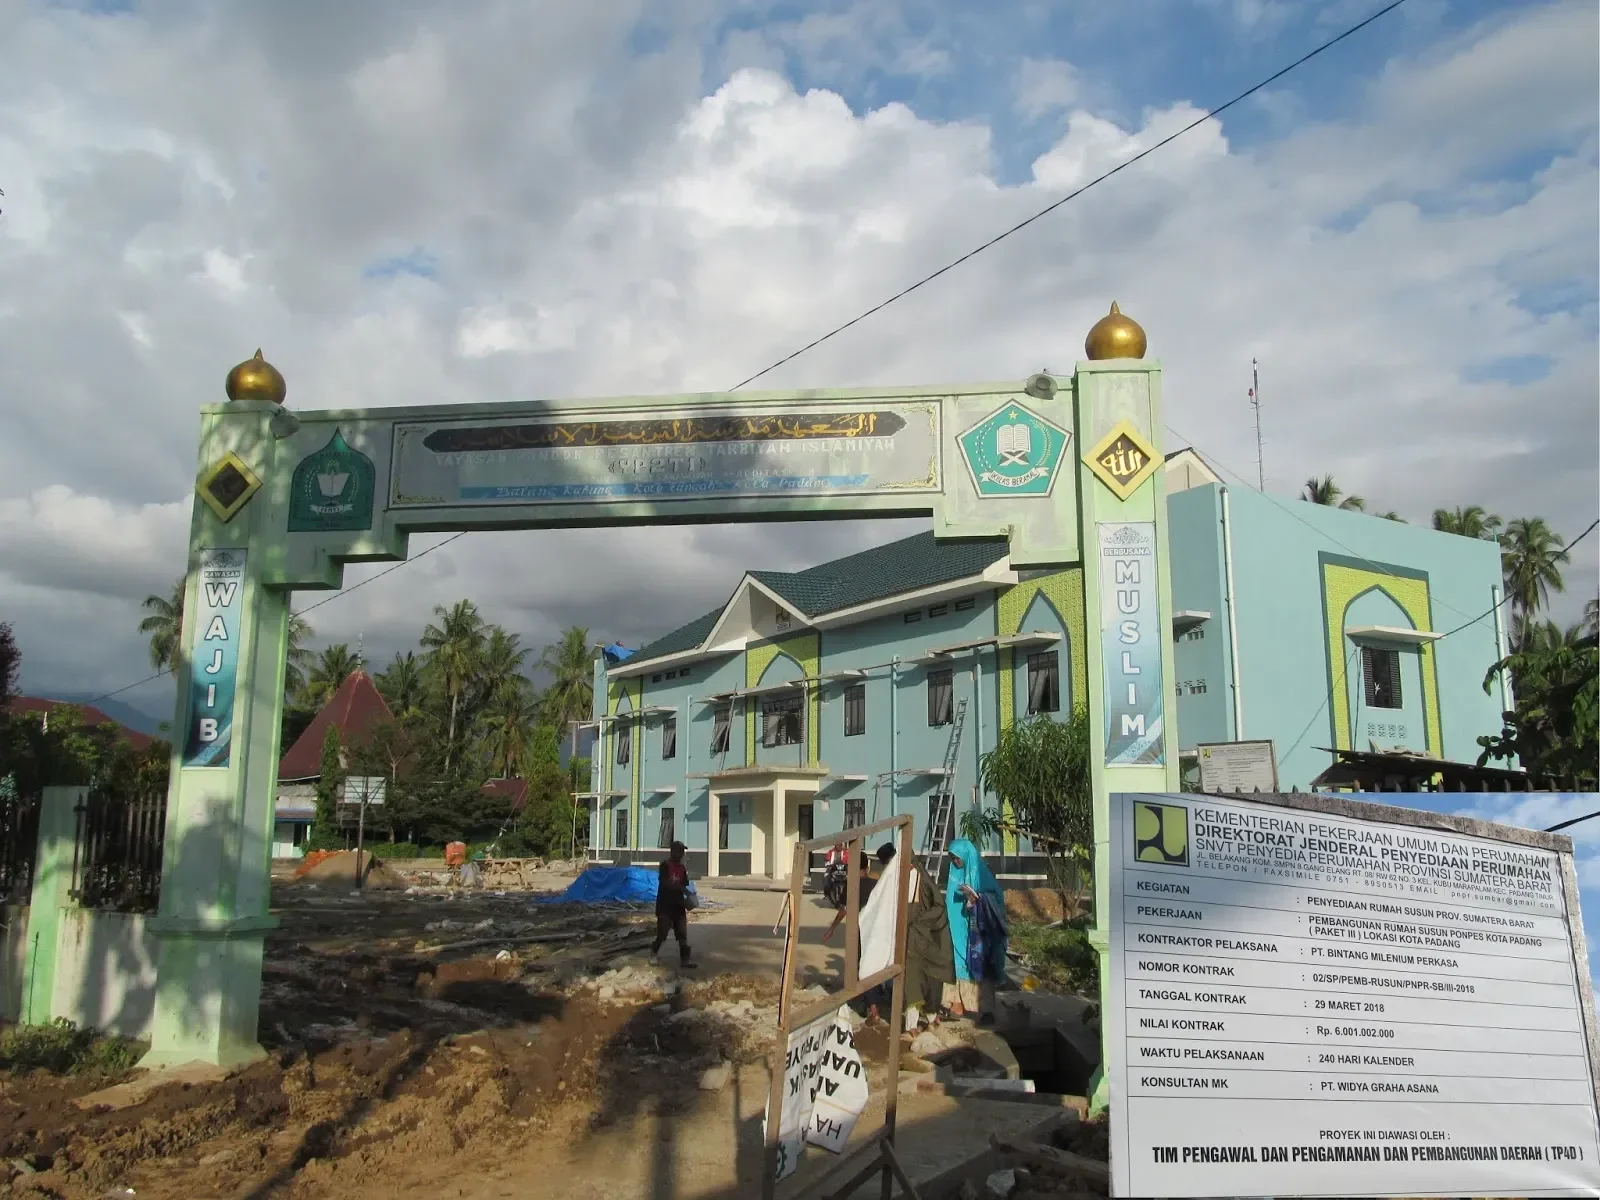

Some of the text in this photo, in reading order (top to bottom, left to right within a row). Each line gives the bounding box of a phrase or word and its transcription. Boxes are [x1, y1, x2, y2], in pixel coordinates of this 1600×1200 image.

[595, 446, 696, 460] PESANTREN
[706, 442, 791, 455] TARBIYAH
[801, 438, 895, 453] ISLAMIYAH
[1012, 470, 1039, 486] BERAMAL
[1103, 547, 1151, 557] BERBUSANA
[203, 569, 241, 579] KAWASAN
[1114, 559, 1145, 737] MUSLIM
[199, 582, 237, 741] WAJIB
[1194, 808, 1550, 868] KEMENTERIAN PEKERJAAN UMUM DAN PERUMAHAN
[1195, 823, 1551, 881] DIREKTORAT JENDERAL PENYEDIAAN PERUMAHAN
[1196, 838, 1552, 893] SNVT PENYEDIA PERUMAHAN PROVINSI SUMATERA BARAT
[1197, 861, 1248, 873] TELEPON
[1264, 867, 1320, 881] FAXSIMILE
[1410, 885, 1438, 895] EMAIL
[1209, 853, 1250, 864] BELAKANG
[1274, 861, 1296, 869] SMPN
[1303, 864, 1325, 873] GANG
[1326, 867, 1351, 876] ELANG
[1376, 872, 1388, 880] RW
[1433, 880, 1452, 888] KUBU
[1452, 882, 1492, 892] MARAPALAM
[1509, 890, 1535, 898] PADANG
[1535, 893, 1554, 901] TIMUR
[1137, 881, 1190, 894] KEGIATAN
[1137, 906, 1202, 920] PEKERJAAN
[1307, 896, 1367, 911] PENYEDIAAN
[1369, 903, 1402, 914] RUMAH
[1404, 907, 1434, 918] SUSUN
[1436, 910, 1462, 921] PROV.
[1463, 914, 1508, 926] SUMATERA
[1508, 920, 1535, 929] BARAT
[1309, 915, 1381, 931] PEMBANGUNAN
[1383, 923, 1416, 934] RUMAH
[1418, 926, 1448, 937] SUSUN
[1450, 930, 1484, 941] PONPES
[1485, 933, 1508, 944] KOTA
[1509, 936, 1542, 947] PADANG
[1315, 926, 1345, 938] PAKET
[1347, 930, 1356, 938] III
[1363, 931, 1397, 942] LOKASI
[1399, 934, 1424, 945] KOTA
[1425, 937, 1461, 948] PADANG
[1138, 933, 1278, 953] KONTRAKTOR PELAKSANA
[1311, 947, 1325, 957] PT.
[1327, 948, 1369, 960] BINTANG
[1370, 952, 1415, 964] MILENIUM
[1416, 956, 1459, 968] PERKASA
[1138, 961, 1235, 977] NOMOR KONTRAK
[1312, 973, 1475, 994] 02/SP/PEMB-RUSUN/PNPR-SB/III-2018
[1139, 989, 1247, 1004] TANGGAL KONTRAK
[1314, 1000, 1326, 1009] 29
[1328, 1001, 1361, 1011] MARET
[1364, 1003, 1385, 1013] 2018
[1140, 1018, 1225, 1031] NILAI KONTRAK
[1316, 1025, 1333, 1037] Rp.
[1334, 1026, 1395, 1038] 6.001.002.000
[1140, 1047, 1265, 1061] WAKTU PELAKSANAAN
[1318, 1054, 1335, 1064] 240
[1337, 1055, 1361, 1064] HARI
[1363, 1056, 1415, 1067] KALENDER
[1141, 1077, 1229, 1089] KONSULTAN MK
[1320, 1081, 1335, 1091] PT.
[1337, 1082, 1369, 1092] WIDYA
[1370, 1082, 1406, 1093] GRAHA
[1406, 1084, 1439, 1093] ASANA
[1319, 1130, 1361, 1140] PROYEK
[1363, 1130, 1376, 1140] INI
[1378, 1131, 1418, 1140] DIAWASI
[1419, 1131, 1445, 1140] OLEH
[1152, 1146, 1178, 1163] TIM
[1182, 1146, 1258, 1163] PENGAWAL
[1261, 1146, 1289, 1162] DAN
[1292, 1146, 1381, 1162] PENGAMANAN
[1383, 1146, 1409, 1161] DAN
[1412, 1146, 1498, 1161] PEMBANGUNAN
[1500, 1146, 1542, 1160] DAERAH
[1551, 1146, 1577, 1160] TP4D
